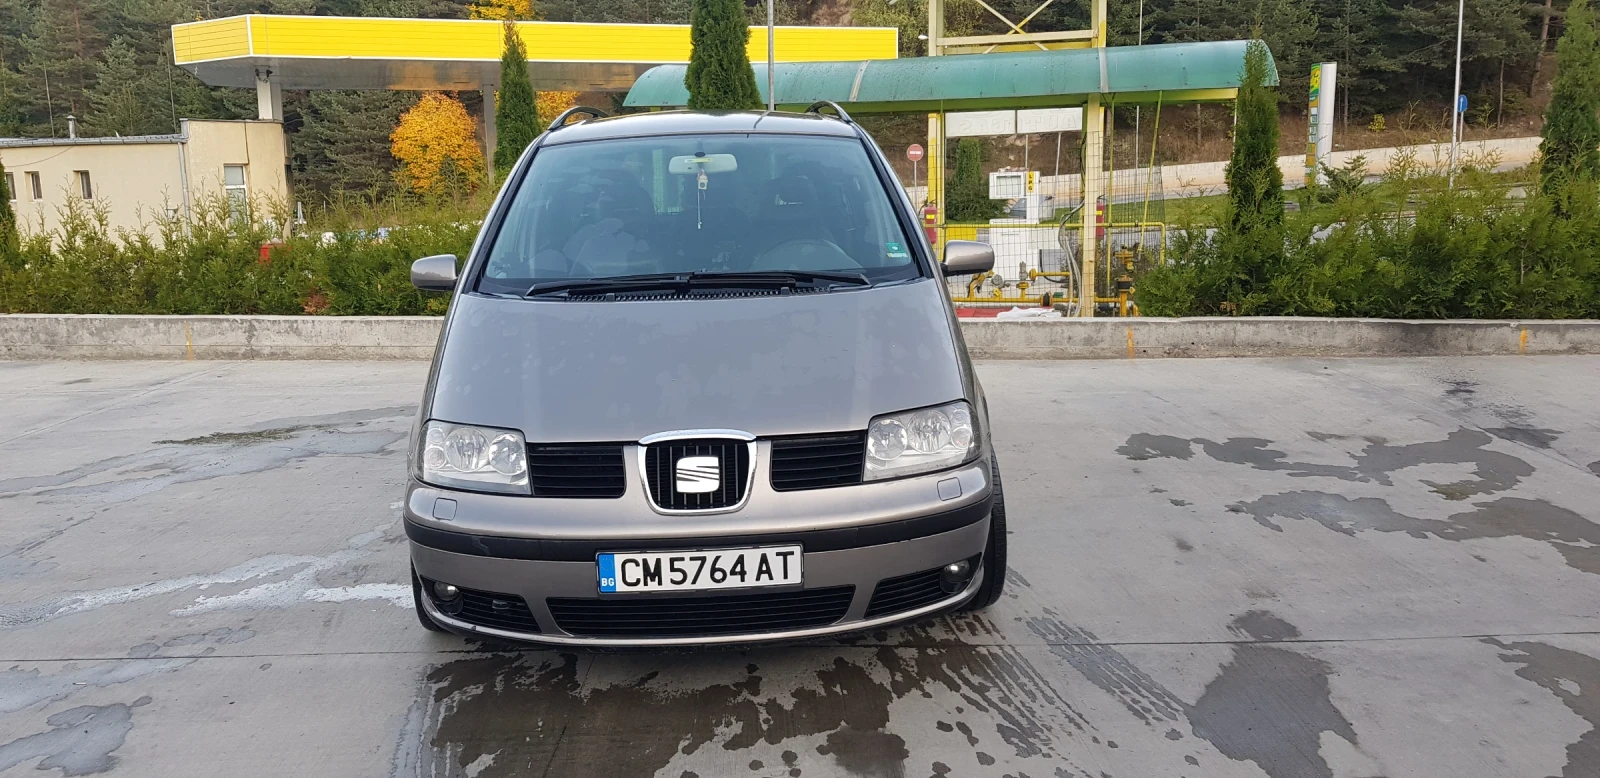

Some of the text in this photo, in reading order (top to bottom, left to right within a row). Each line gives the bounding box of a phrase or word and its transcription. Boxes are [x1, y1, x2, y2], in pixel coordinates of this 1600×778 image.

[669, 553, 747, 586] 5764
[755, 550, 795, 582] AT
[601, 577, 615, 587] BG
